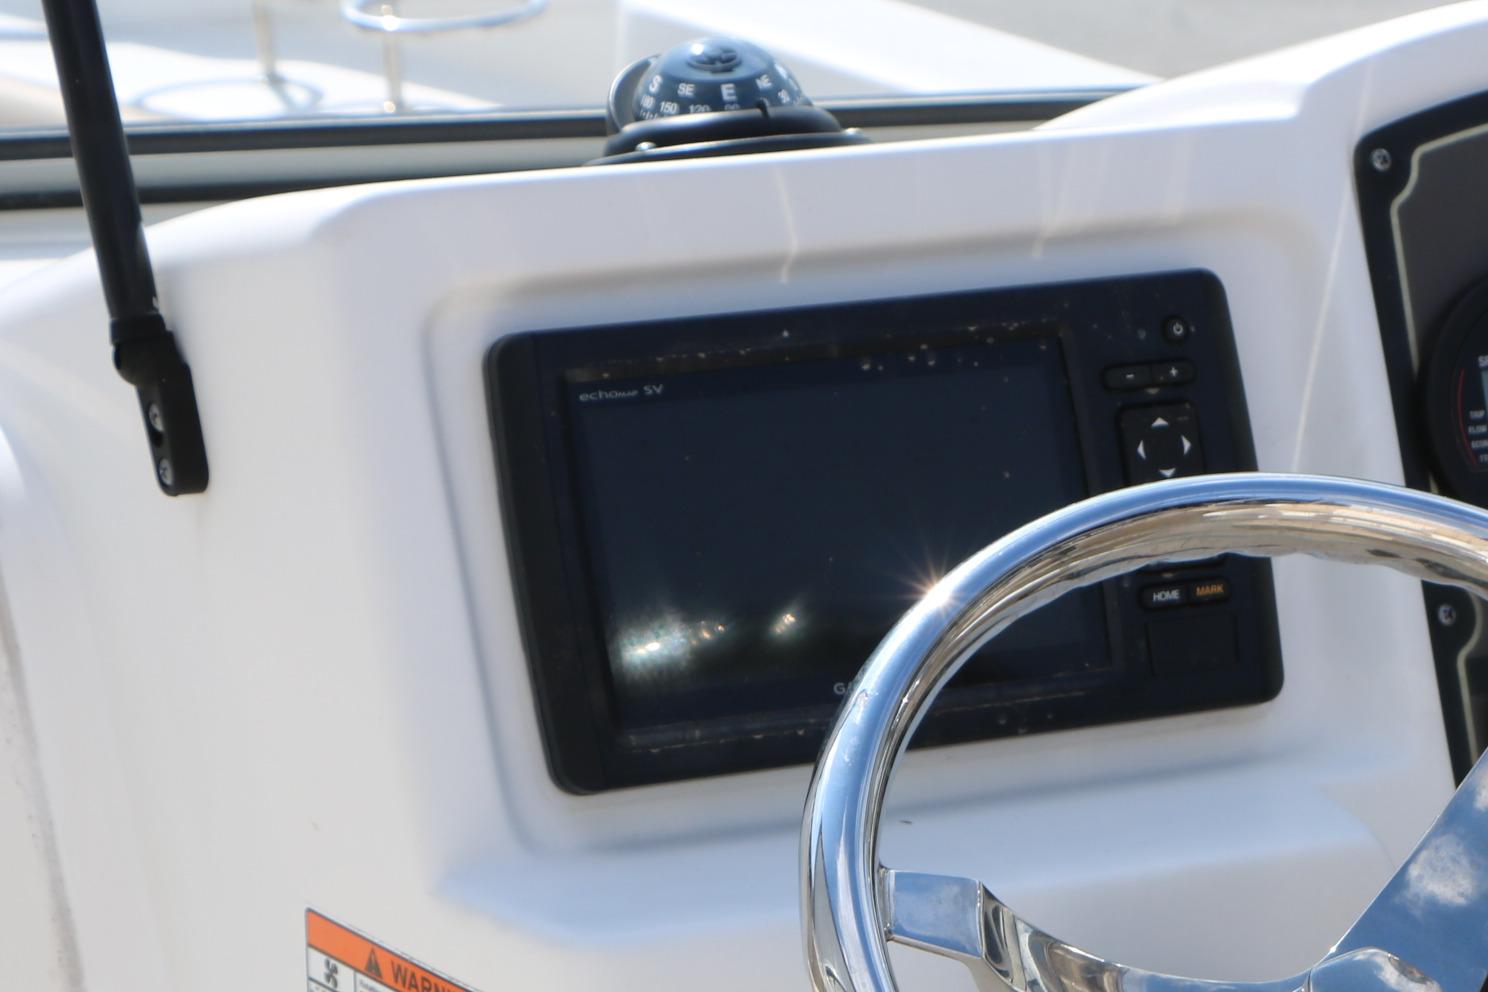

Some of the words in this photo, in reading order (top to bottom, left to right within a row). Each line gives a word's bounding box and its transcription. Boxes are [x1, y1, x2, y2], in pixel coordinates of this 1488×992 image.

[649, 74, 663, 92] S
[677, 83, 695, 97] SE
[721, 83, 737, 101] E
[1152, 589, 1180, 602] HOME
[1196, 584, 1224, 597] MARK
